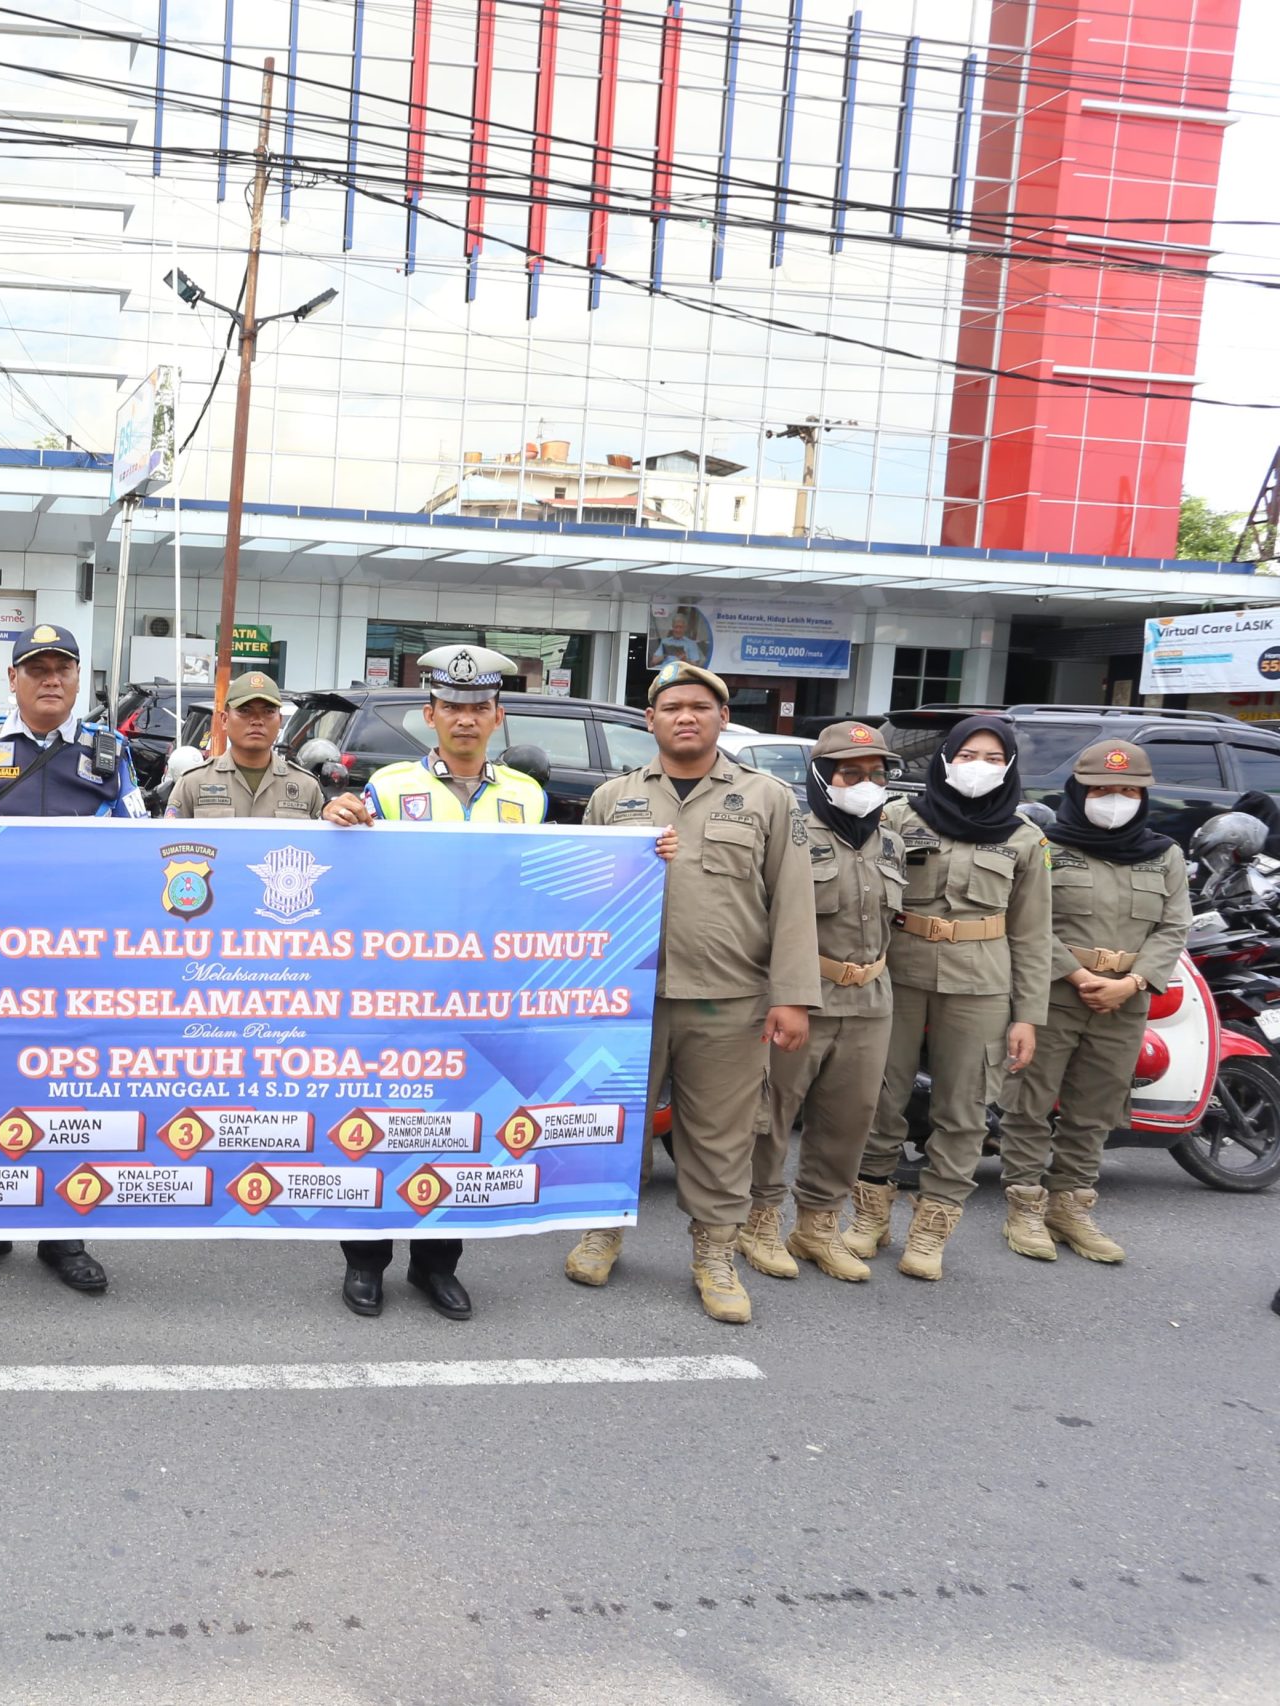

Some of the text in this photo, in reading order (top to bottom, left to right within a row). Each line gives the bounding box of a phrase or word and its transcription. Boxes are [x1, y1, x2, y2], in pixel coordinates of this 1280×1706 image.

[0, 615, 25, 624] smec
[232, 628, 257, 639] ATM
[1157, 619, 1274, 638] Virtual Care LASIK
[231, 641, 268, 652] NTER
[746, 645, 759, 656] Rp
[1261, 660, 1280, 672] 55
[162, 846, 216, 857] SUMATERA UTARA
[113, 928, 214, 958] LALU
[220, 929, 354, 959] LINTAS
[361, 930, 485, 960] POLDA
[492, 931, 610, 960] SUMUT
[181, 961, 312, 982] Melaksanakan
[64, 988, 342, 1019] KESELAMATAN
[349, 989, 513, 1019] BERLALU
[518, 987, 631, 1018] LINTAS
[181, 1022, 308, 1044] Dalam Rangka
[18, 1046, 466, 1079] OPS PATUH TOBA-2025
[47, 1081, 434, 1099] MULAI TANGGAL 14 S.D 27 JULI 2025
[49, 1119, 102, 1131] LAWAN
[219, 1113, 298, 1125] GUNAKAN HP
[388, 1115, 452, 1126] MENGEMUDIKAN
[545, 1112, 597, 1126] PENGEMUDI
[7, 1123, 24, 1146] 2
[178, 1122, 193, 1146] 3
[219, 1126, 250, 1136] SAAT
[348, 1122, 365, 1146] 4
[388, 1127, 451, 1137] RANMOR DALAM
[512, 1121, 526, 1145] 5
[544, 1125, 614, 1141] DIBAWAH UMUR
[48, 1132, 91, 1145] ARUS
[218, 1137, 301, 1149] BERKENDARA
[387, 1138, 469, 1149] PENGARUH ALKOHOL
[117, 1170, 179, 1180] KNALPOT
[288, 1174, 342, 1186] TEROBOS
[456, 1169, 524, 1181] GAR MARKA
[77, 1178, 93, 1201] 7
[117, 1181, 193, 1192] TDK SESUAI
[247, 1177, 263, 1201] 8
[417, 1179, 431, 1202] 9
[456, 1180, 523, 1192] DAN RAMBU
[117, 1193, 177, 1203] SPEKTEK
[287, 1188, 370, 1201] TRAFFIC LIGHT
[455, 1193, 490, 1203] LALIN
